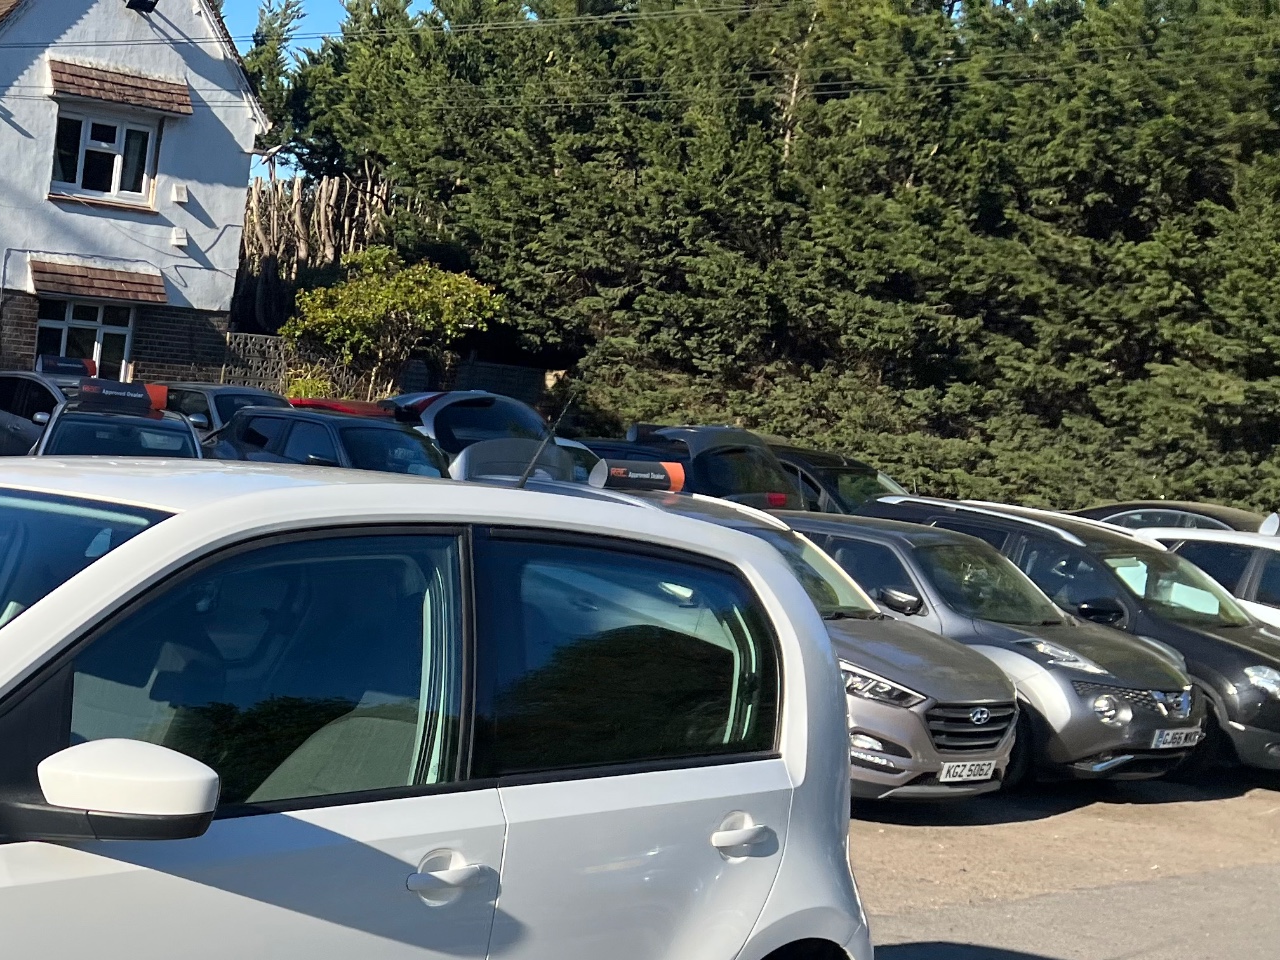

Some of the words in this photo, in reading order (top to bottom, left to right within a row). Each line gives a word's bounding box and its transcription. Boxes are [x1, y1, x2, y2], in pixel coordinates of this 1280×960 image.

[102, 389, 126, 397] Approved
[126, 391, 144, 399] Dealer
[628, 471, 650, 479] Approved
[944, 764, 968, 779] KGZ
[966, 762, 993, 777] 5062
